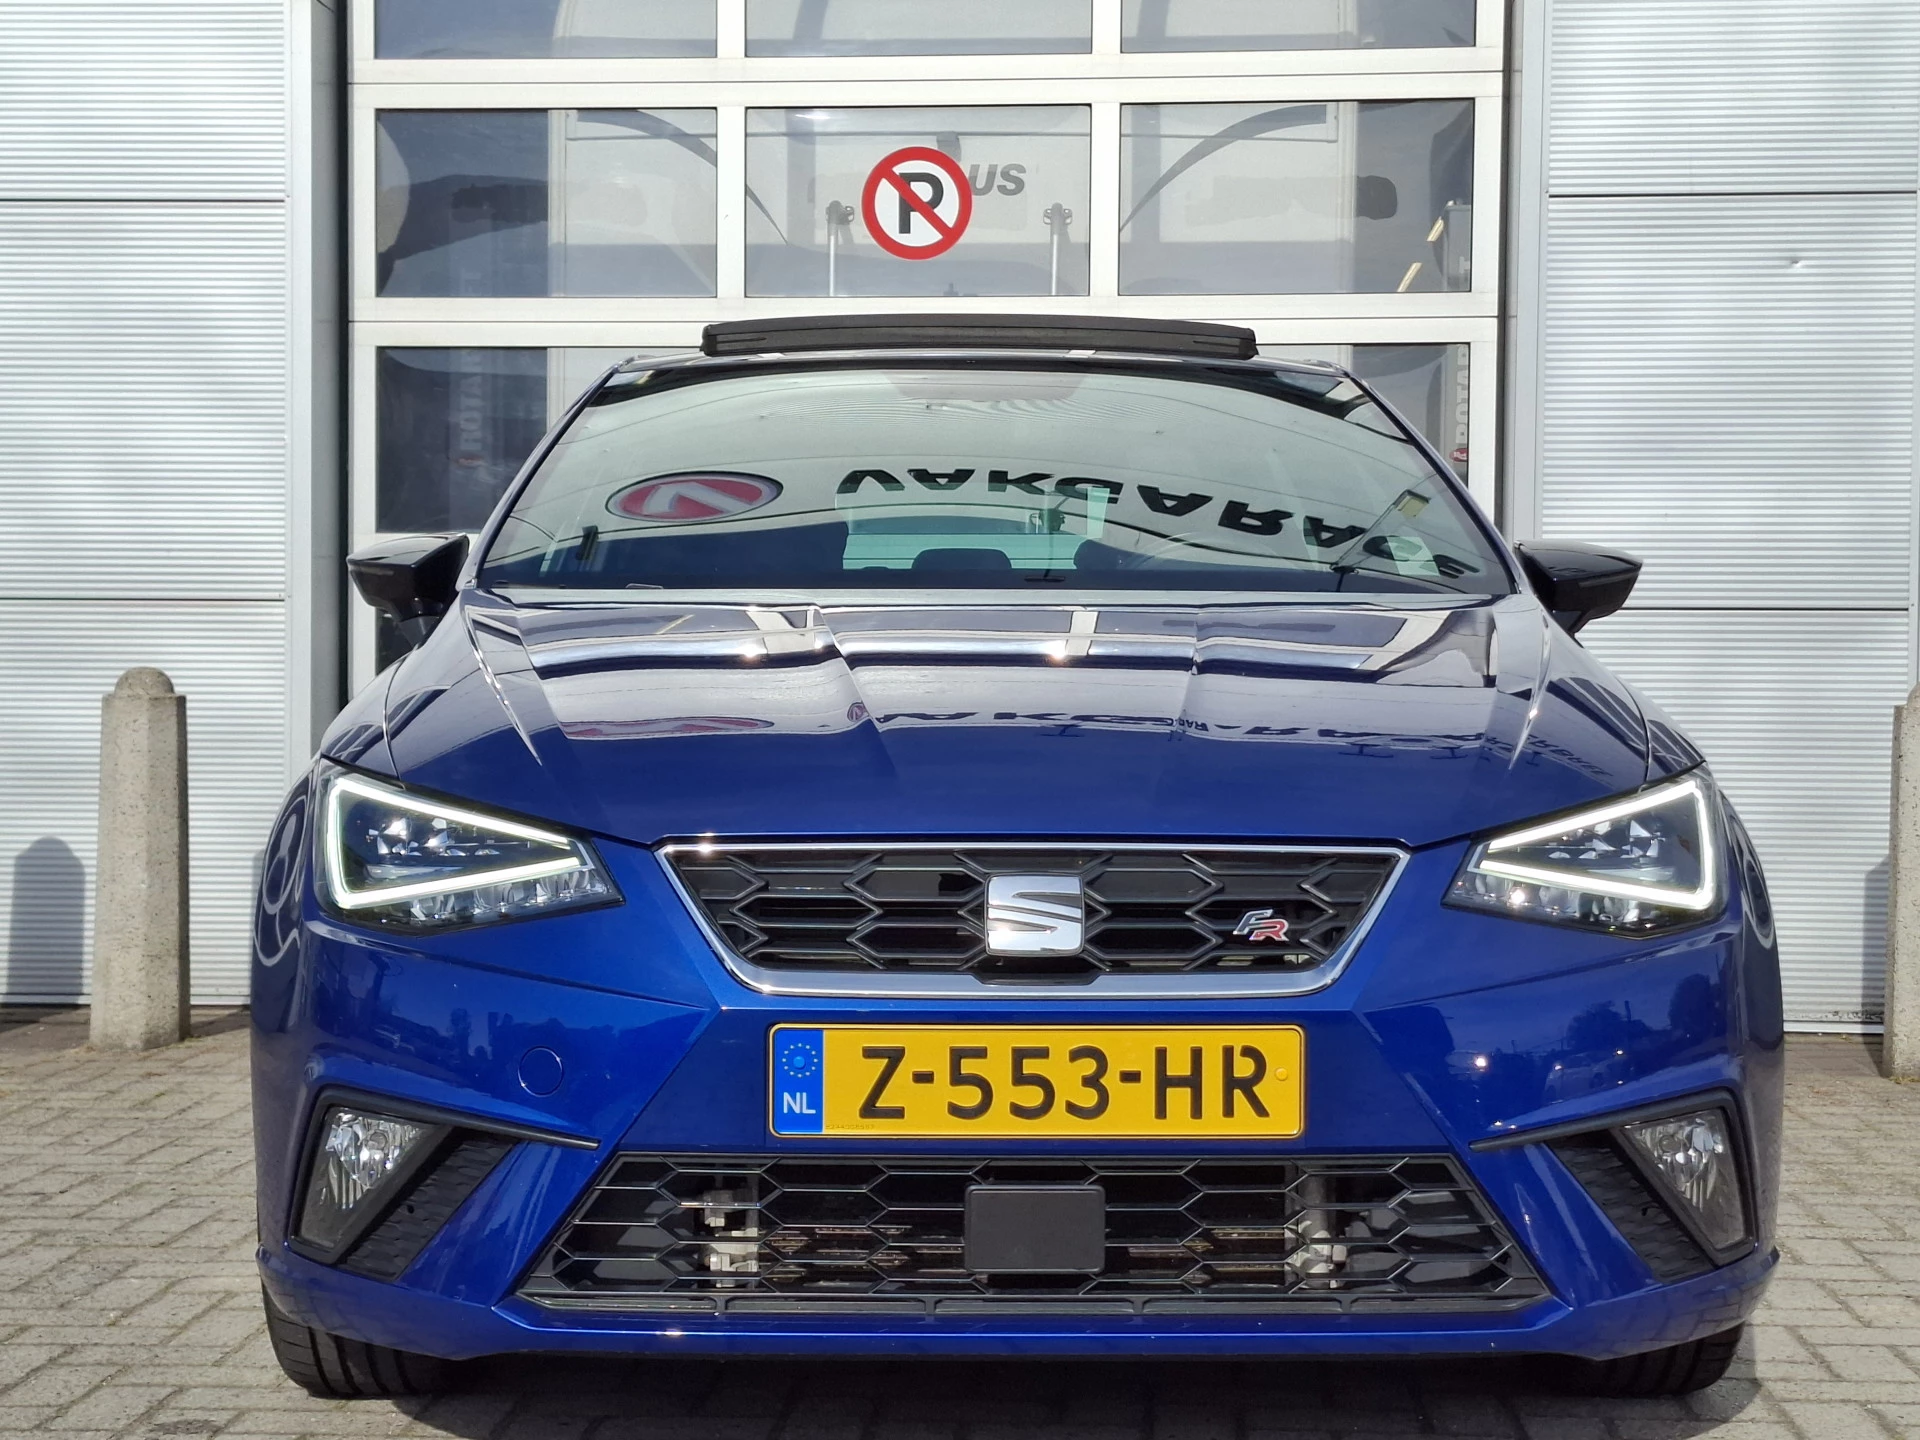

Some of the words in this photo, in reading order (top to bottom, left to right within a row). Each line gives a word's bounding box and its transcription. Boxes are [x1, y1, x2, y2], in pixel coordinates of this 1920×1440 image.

[899, 172, 944, 234] P
[1233, 909, 1290, 942] FR
[782, 1091, 816, 1114] NL
[858, 1044, 1271, 1120] Z-553-HR
